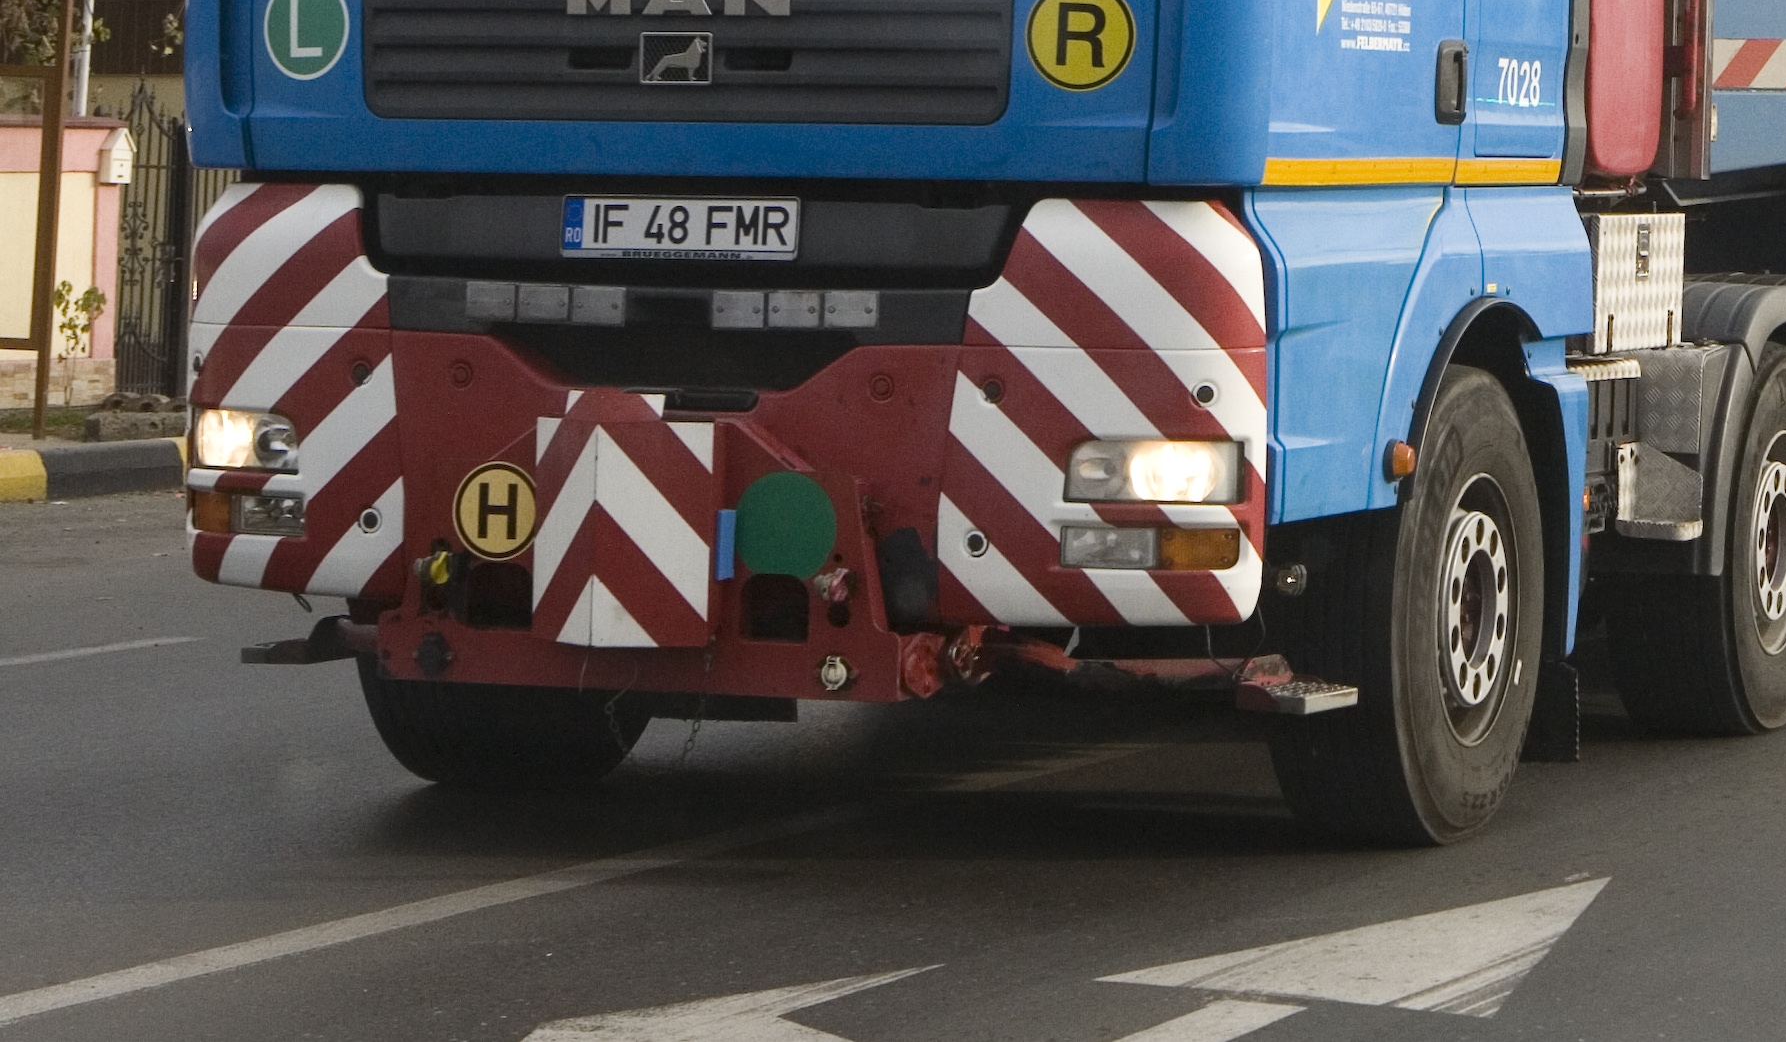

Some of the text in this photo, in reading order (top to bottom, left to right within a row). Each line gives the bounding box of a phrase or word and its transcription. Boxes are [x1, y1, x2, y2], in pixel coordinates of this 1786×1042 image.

[1055, 3, 1106, 69] R
[1498, 57, 1542, 107] 7028
[564, 204, 790, 246] RO IF 48 FMR
[477, 483, 518, 540] H
